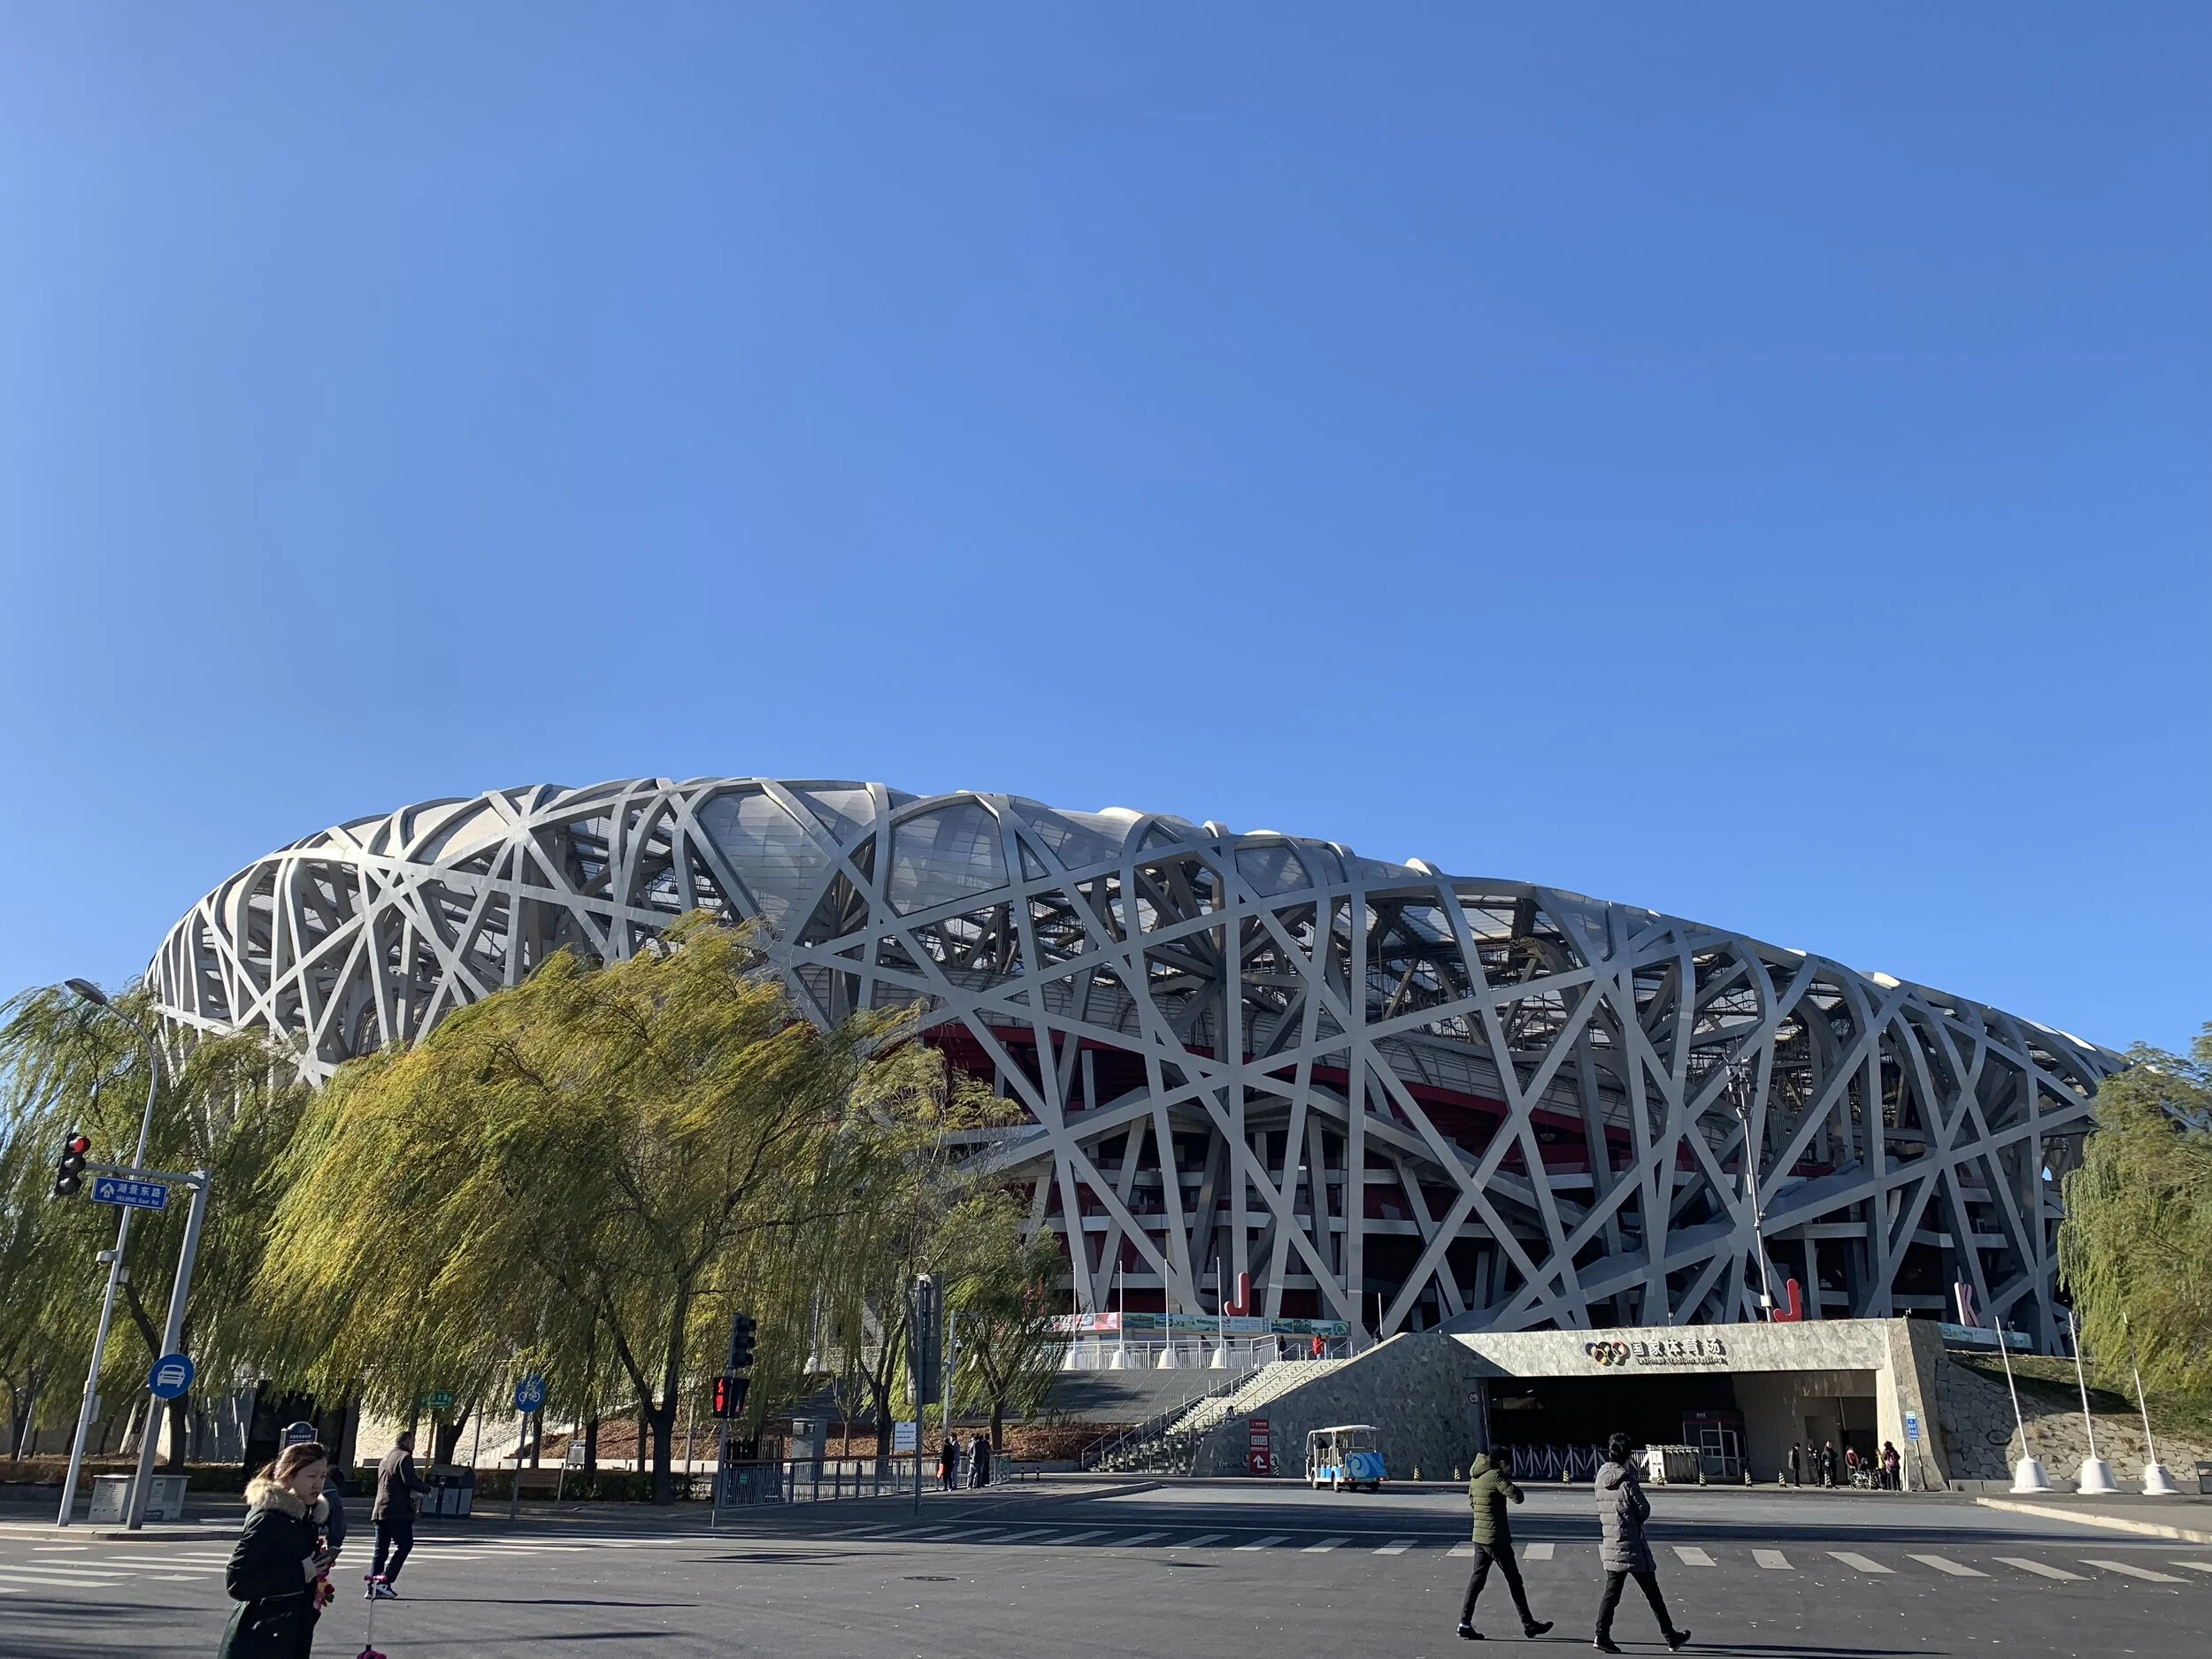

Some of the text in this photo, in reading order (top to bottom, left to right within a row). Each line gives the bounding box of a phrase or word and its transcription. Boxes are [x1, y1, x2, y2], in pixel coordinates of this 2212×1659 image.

[117, 1183, 161, 1198] 湖景东路
[1224, 1271, 1249, 1317] J
[1773, 1278, 1802, 1323] J
[1955, 1282, 1981, 1327] K
[1632, 1338, 1723, 1356] 国家体育场
